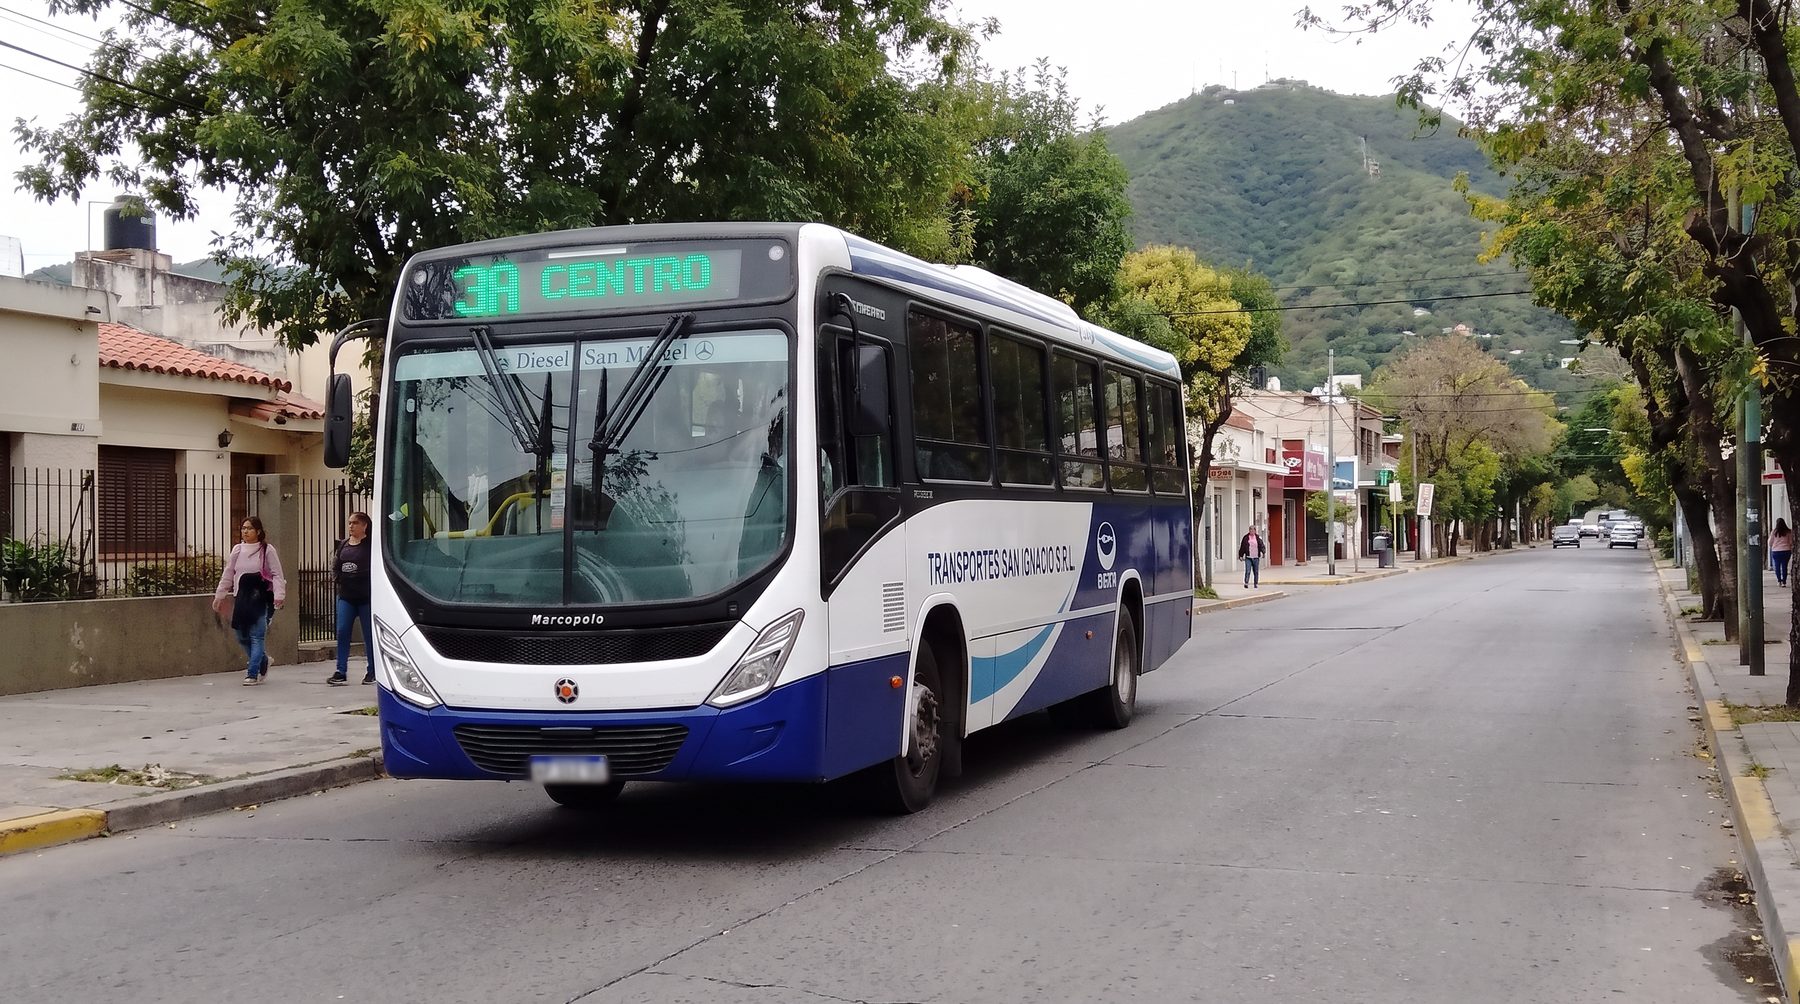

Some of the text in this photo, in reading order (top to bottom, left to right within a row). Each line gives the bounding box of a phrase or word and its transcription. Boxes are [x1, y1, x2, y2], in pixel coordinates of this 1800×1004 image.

[453, 254, 711, 315] 3A CENTRO
[516, 343, 688, 369] Diesel San Muel
[927, 545, 1076, 585] TRANSPORTES SAN IGNACIO S.R.L.
[531, 613, 604, 626] Marcopolo
